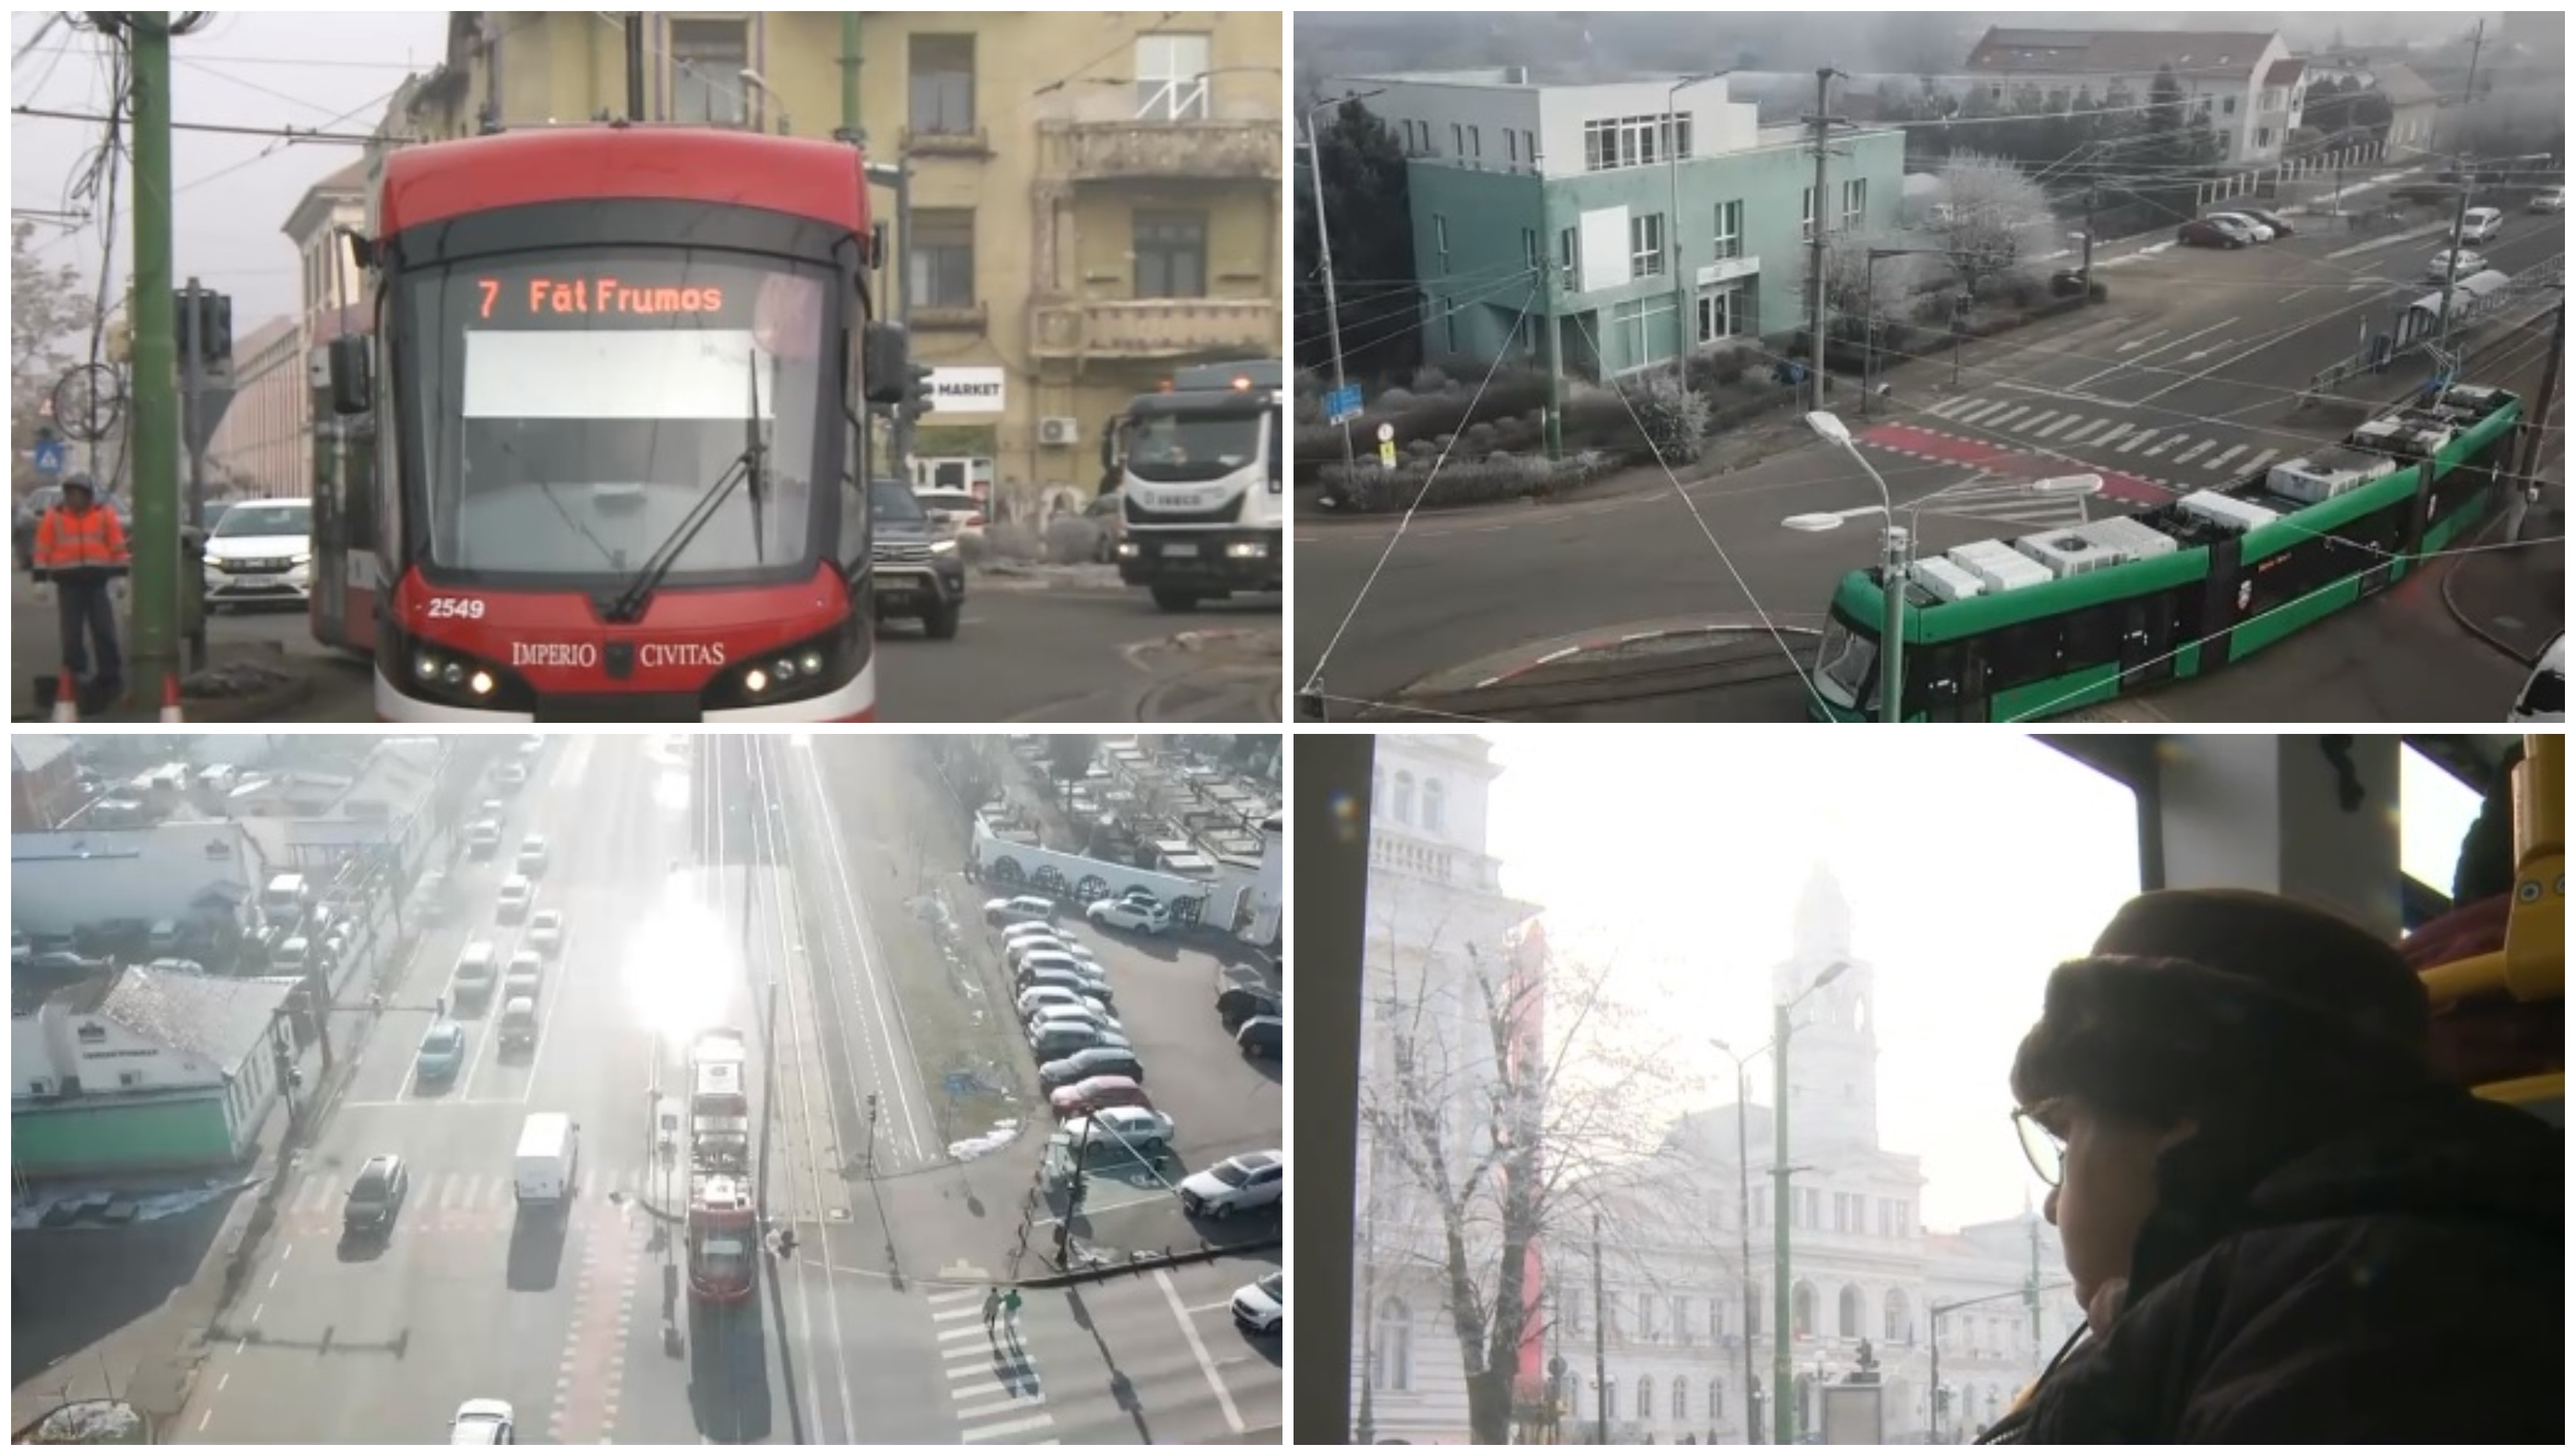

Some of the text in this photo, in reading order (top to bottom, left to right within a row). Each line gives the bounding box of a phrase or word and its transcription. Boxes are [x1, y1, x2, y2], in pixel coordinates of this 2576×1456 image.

[478, 280, 500, 318] 7
[596, 279, 722, 313] Frumos
[938, 384, 1000, 396] MARKET
[429, 597, 484, 619] 2549
[512, 642, 724, 666] IMPERIO CIVITAS
